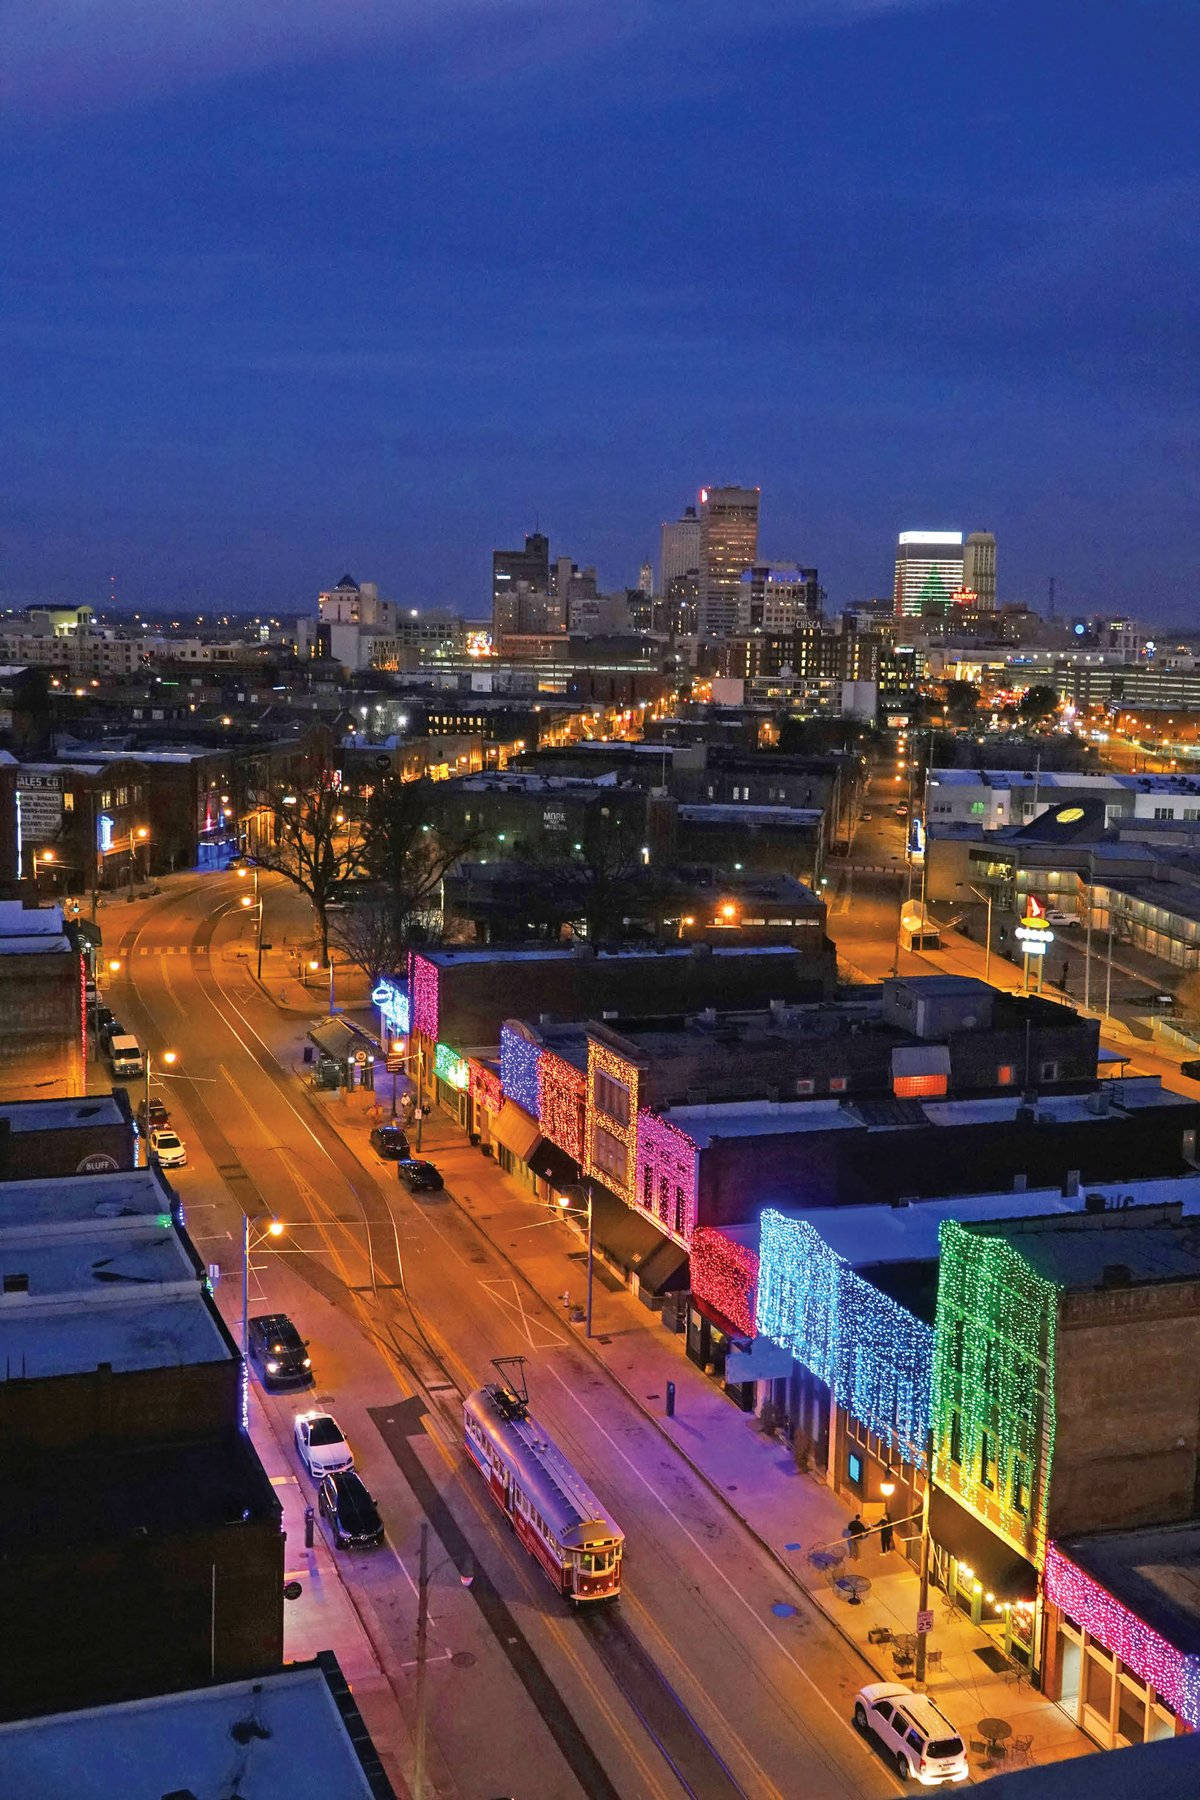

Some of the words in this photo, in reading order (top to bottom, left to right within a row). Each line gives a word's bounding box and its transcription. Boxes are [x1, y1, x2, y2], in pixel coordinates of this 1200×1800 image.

[796, 620, 822, 629] CHISCA
[86, 1161, 109, 1170] BLUFF
[918, 1621, 932, 1631] 25
